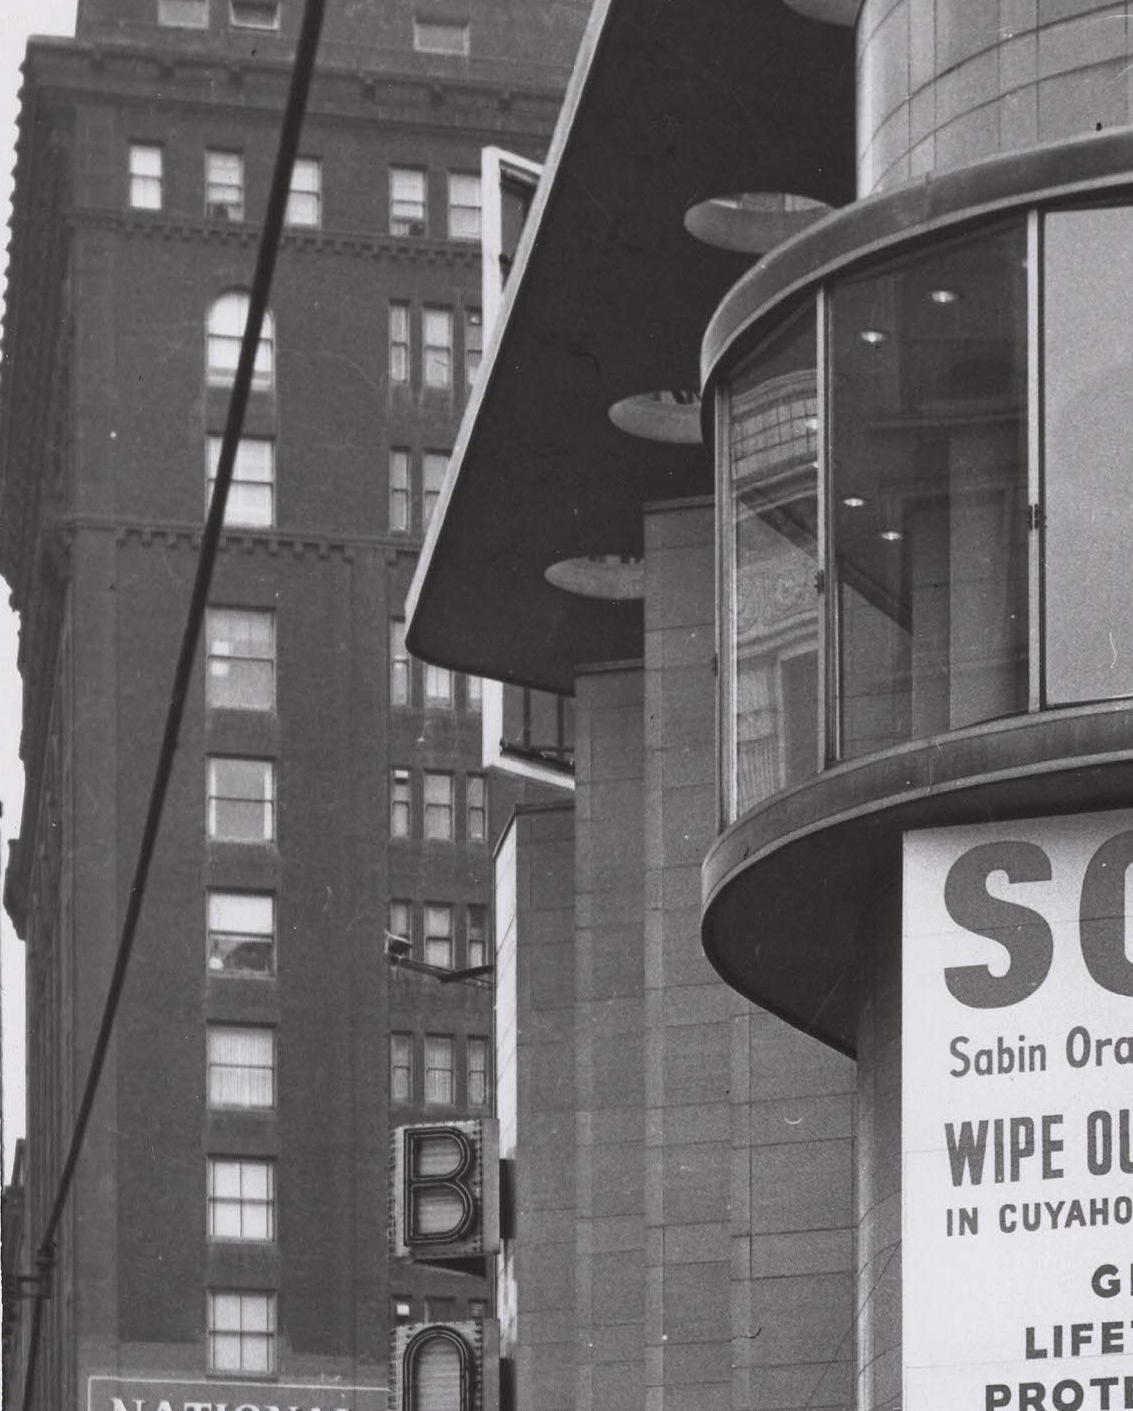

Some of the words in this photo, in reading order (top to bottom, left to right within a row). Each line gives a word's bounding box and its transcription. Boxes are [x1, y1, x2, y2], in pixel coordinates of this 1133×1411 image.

[949, 1033, 1046, 1078] Sabin
[944, 1114, 1064, 1187] WIPE
[946, 1207, 979, 1237] IN
